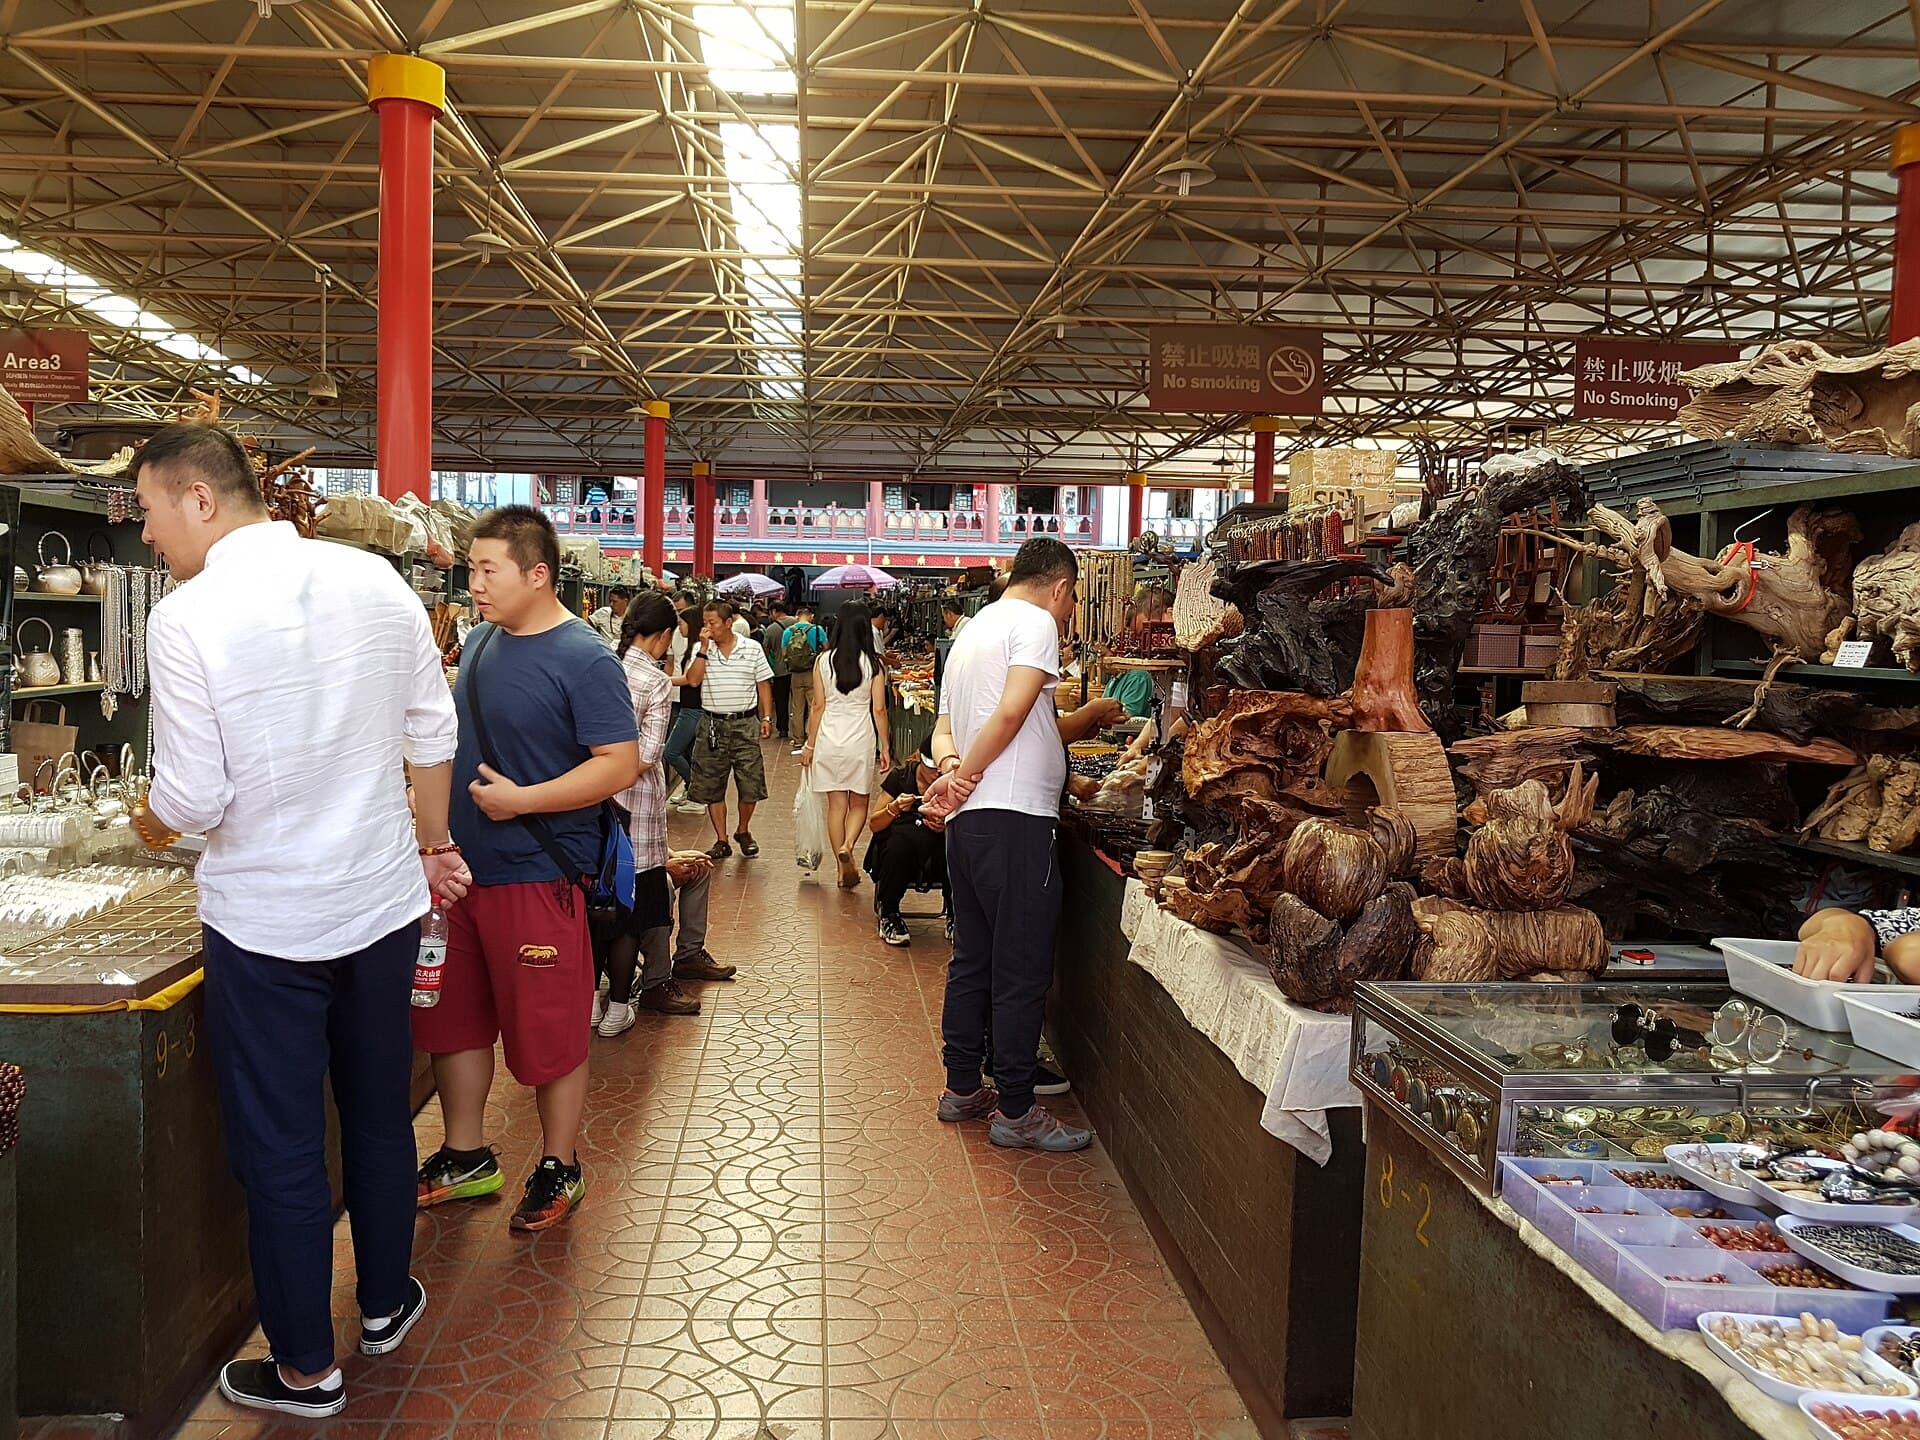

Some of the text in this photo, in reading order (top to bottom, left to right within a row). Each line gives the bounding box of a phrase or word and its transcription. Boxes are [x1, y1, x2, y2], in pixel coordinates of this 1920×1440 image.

[3, 352, 62, 370] Area3
[1161, 342, 1261, 369] 禁止吸烟
[1163, 374, 1260, 393] No smoking
[1582, 356, 1683, 386] 禁止吸烟
[1583, 390, 1678, 410] No Smoking
[156, 1012, 196, 1079] 9-3
[1380, 1152, 1432, 1249] 8-2
